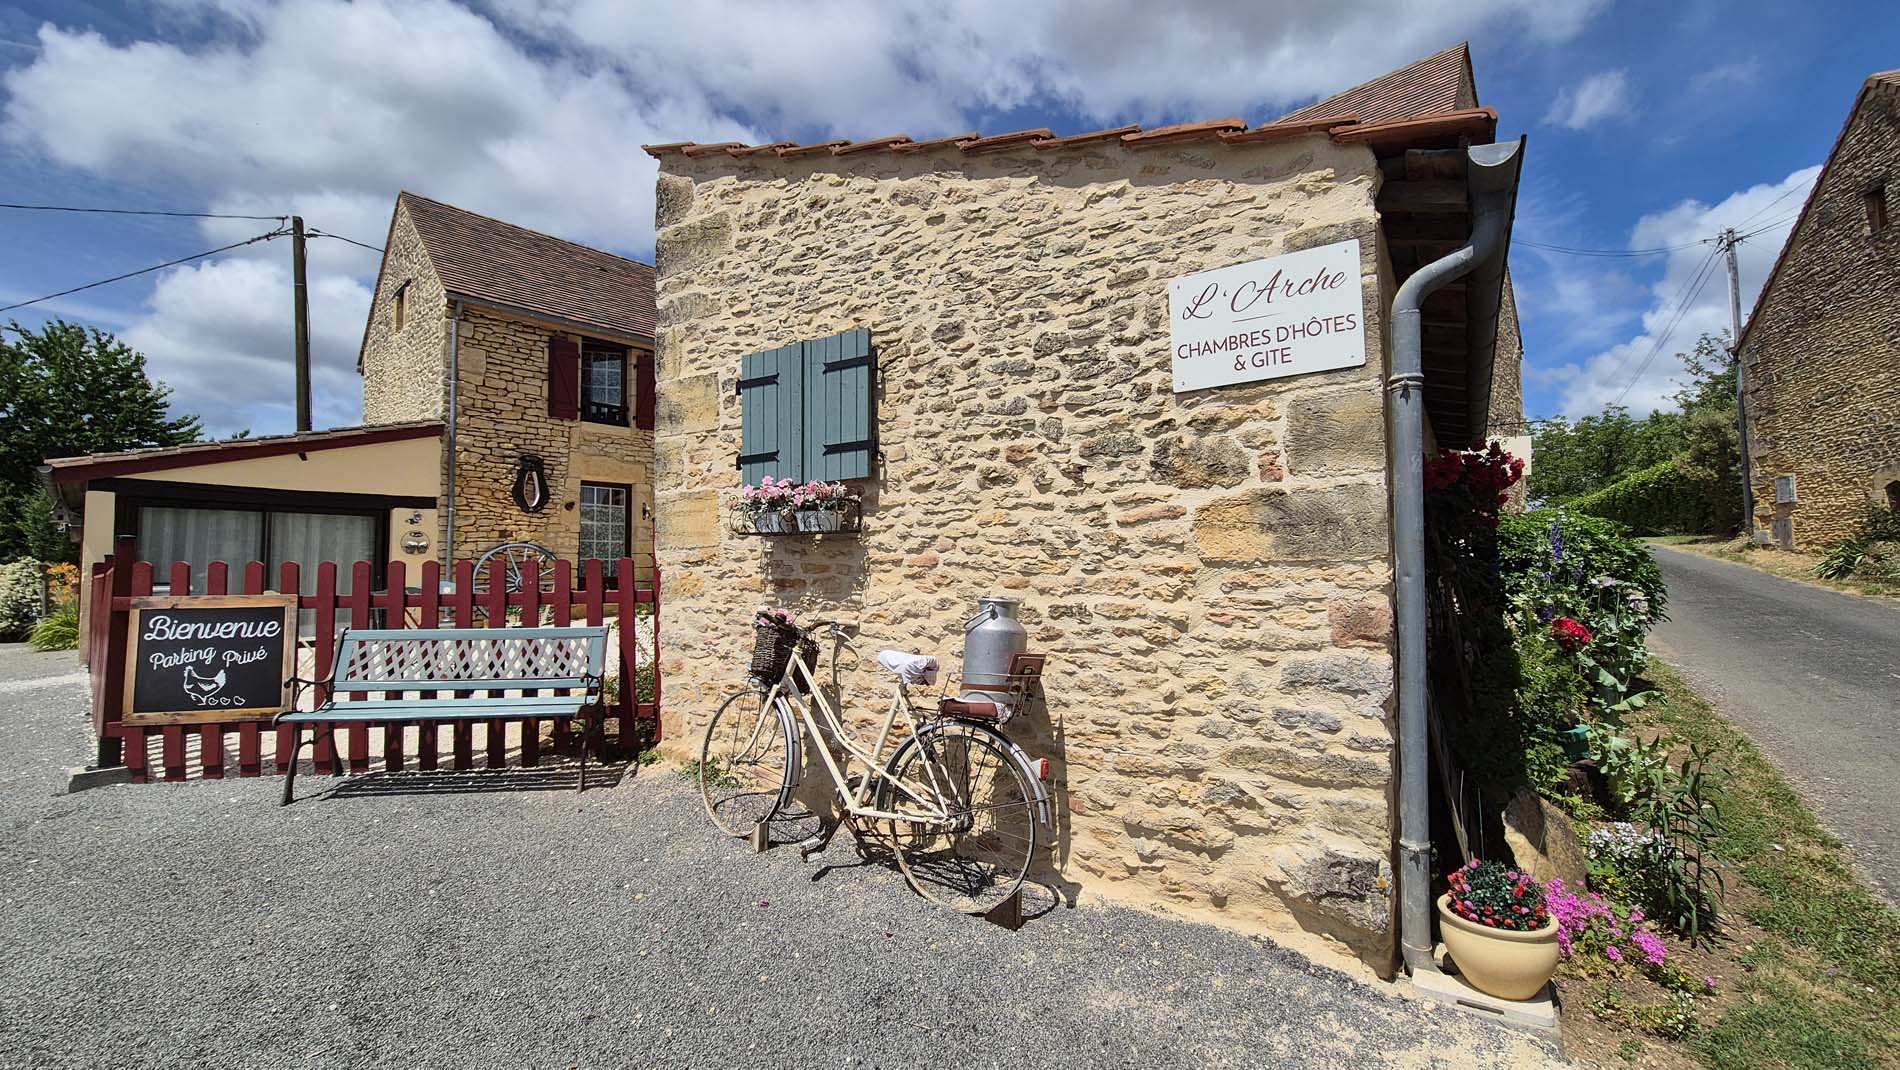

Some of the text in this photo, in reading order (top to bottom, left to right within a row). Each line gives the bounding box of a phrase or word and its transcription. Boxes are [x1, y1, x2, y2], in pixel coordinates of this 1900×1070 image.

[1177, 313, 1357, 360] CHAMBRES D'HÔTES
[1233, 346, 1293, 371] & GITE
[143, 615, 281, 641] Bienvenue
[149, 645, 268, 671] Parking Privé
